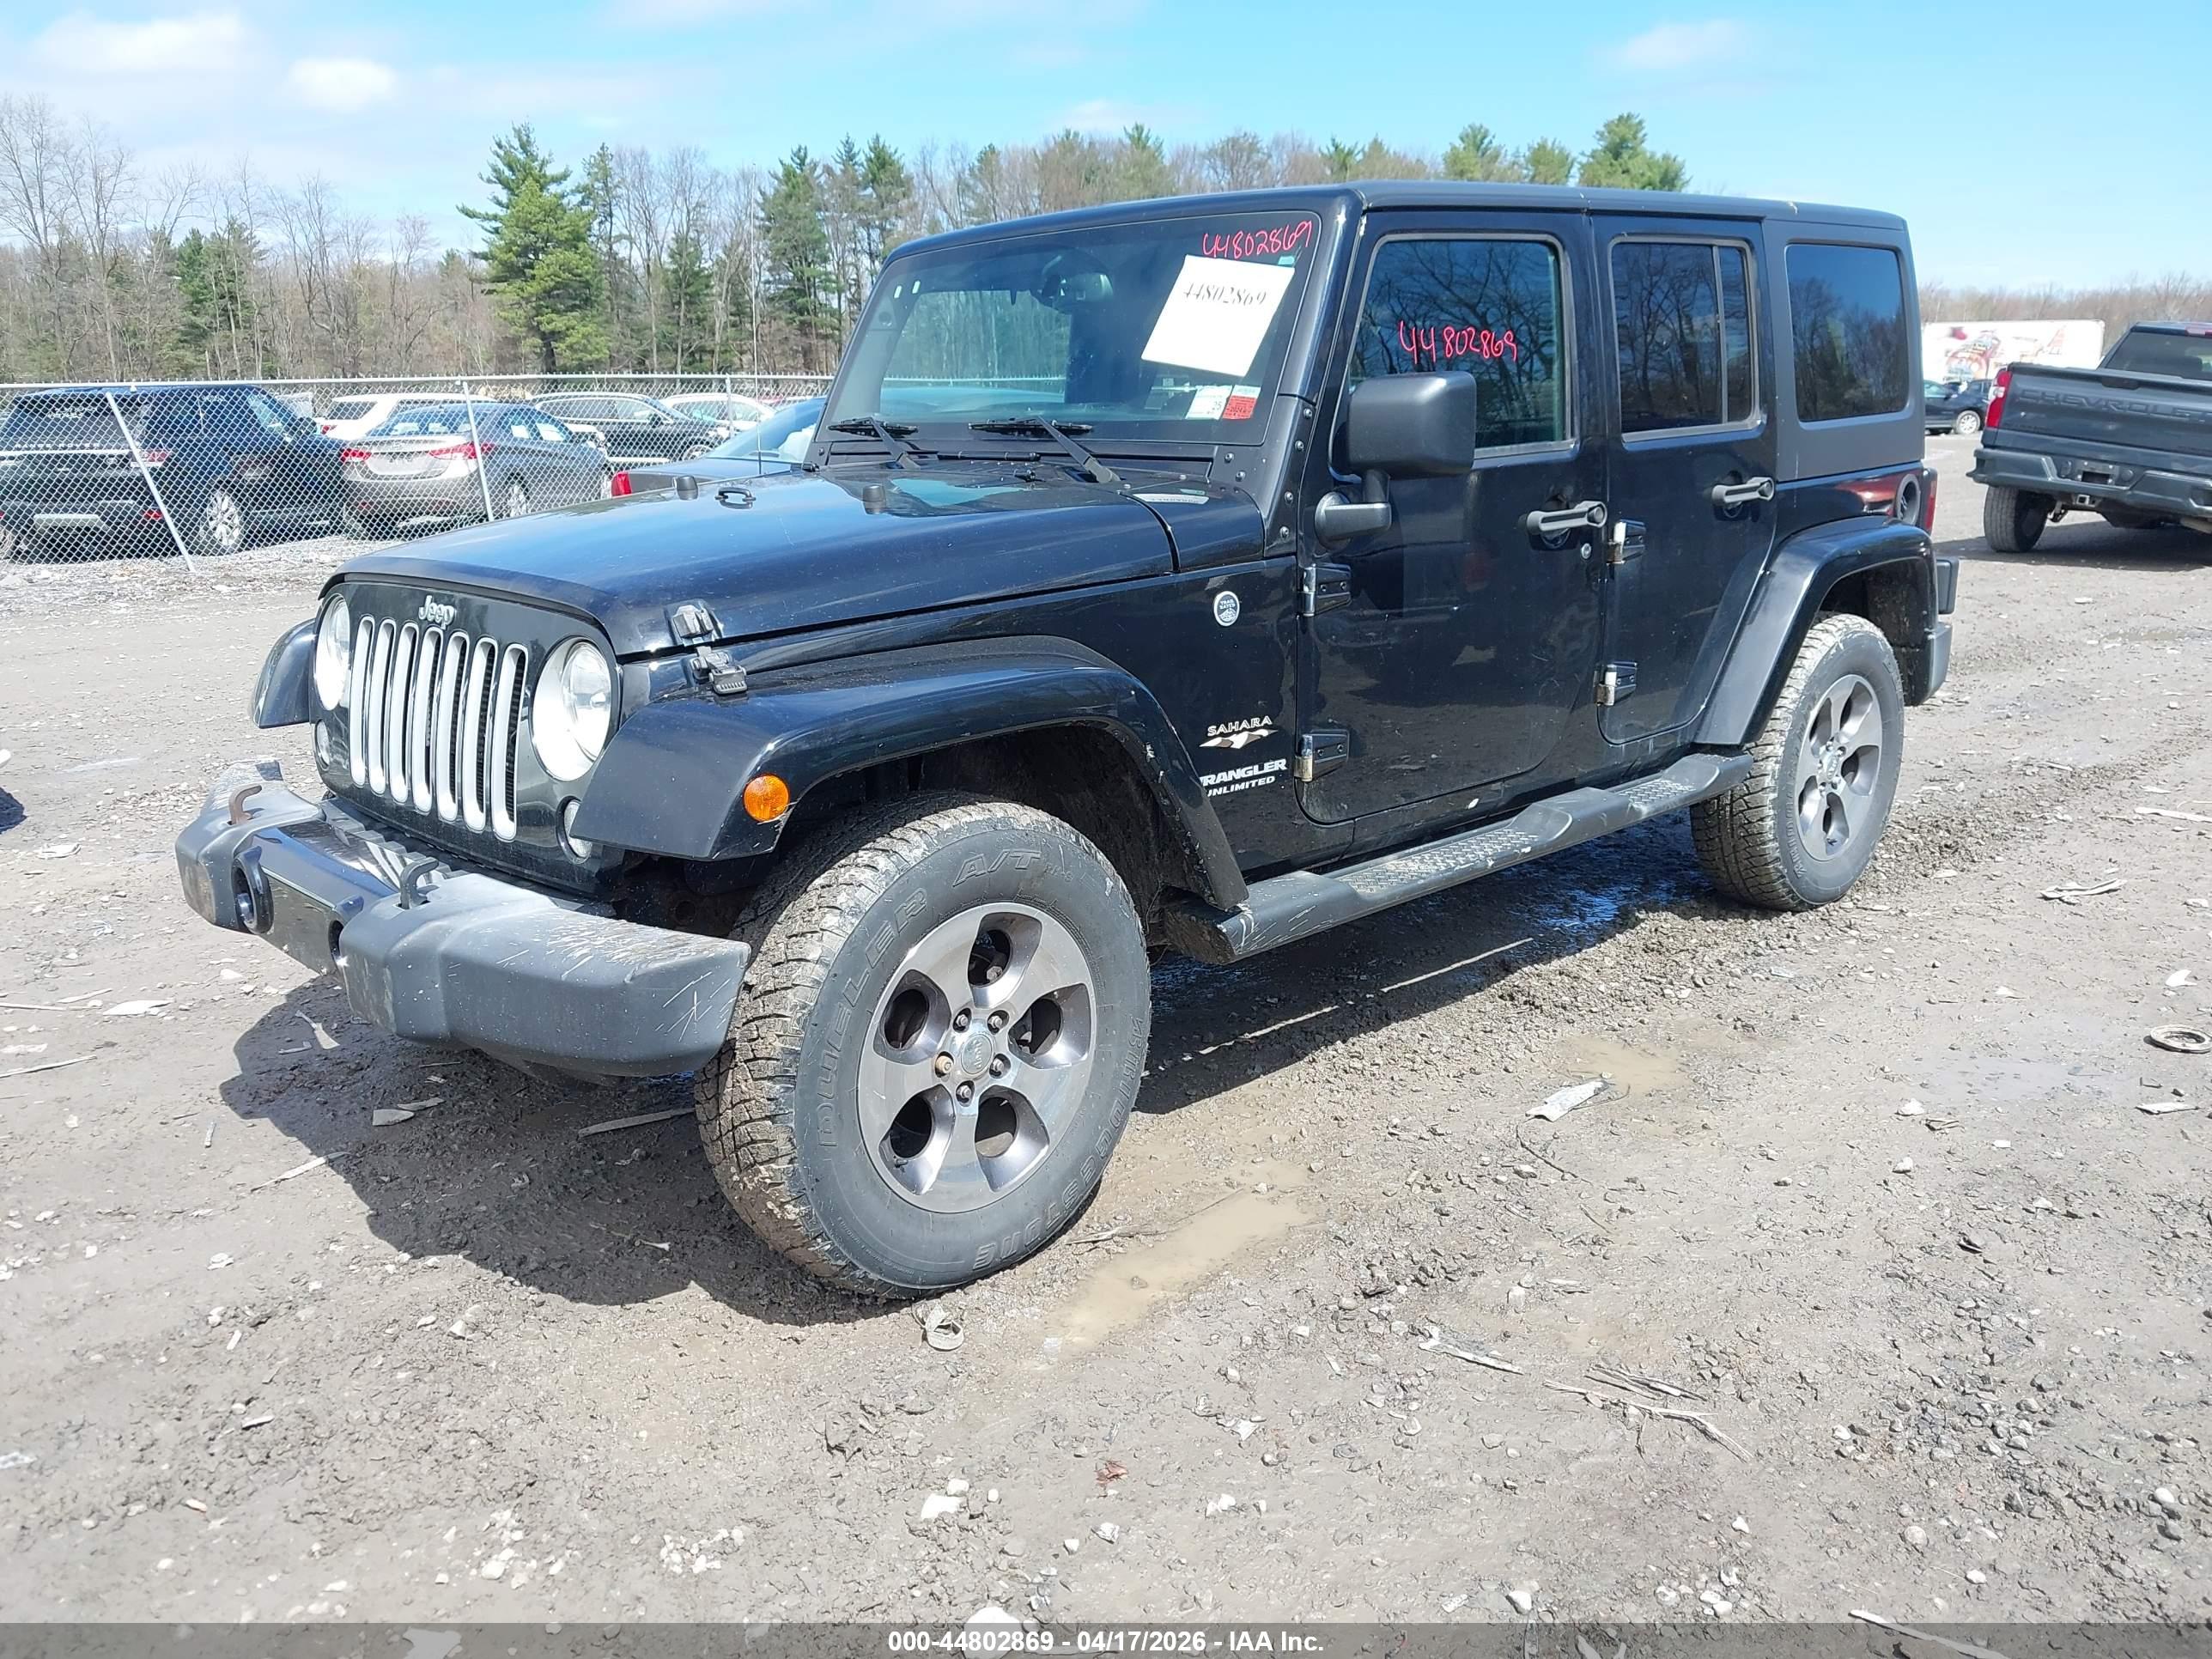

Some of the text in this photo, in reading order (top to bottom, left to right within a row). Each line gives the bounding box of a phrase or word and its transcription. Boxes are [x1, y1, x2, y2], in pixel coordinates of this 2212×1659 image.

[1202, 220, 1312, 259] 44802869
[1183, 282, 1267, 307] 44802869
[419, 595, 455, 630] Jeep
[1207, 715, 1273, 737] SAHARA
[817, 887, 927, 1146] DUELER
[952, 849, 1042, 887] A/T
